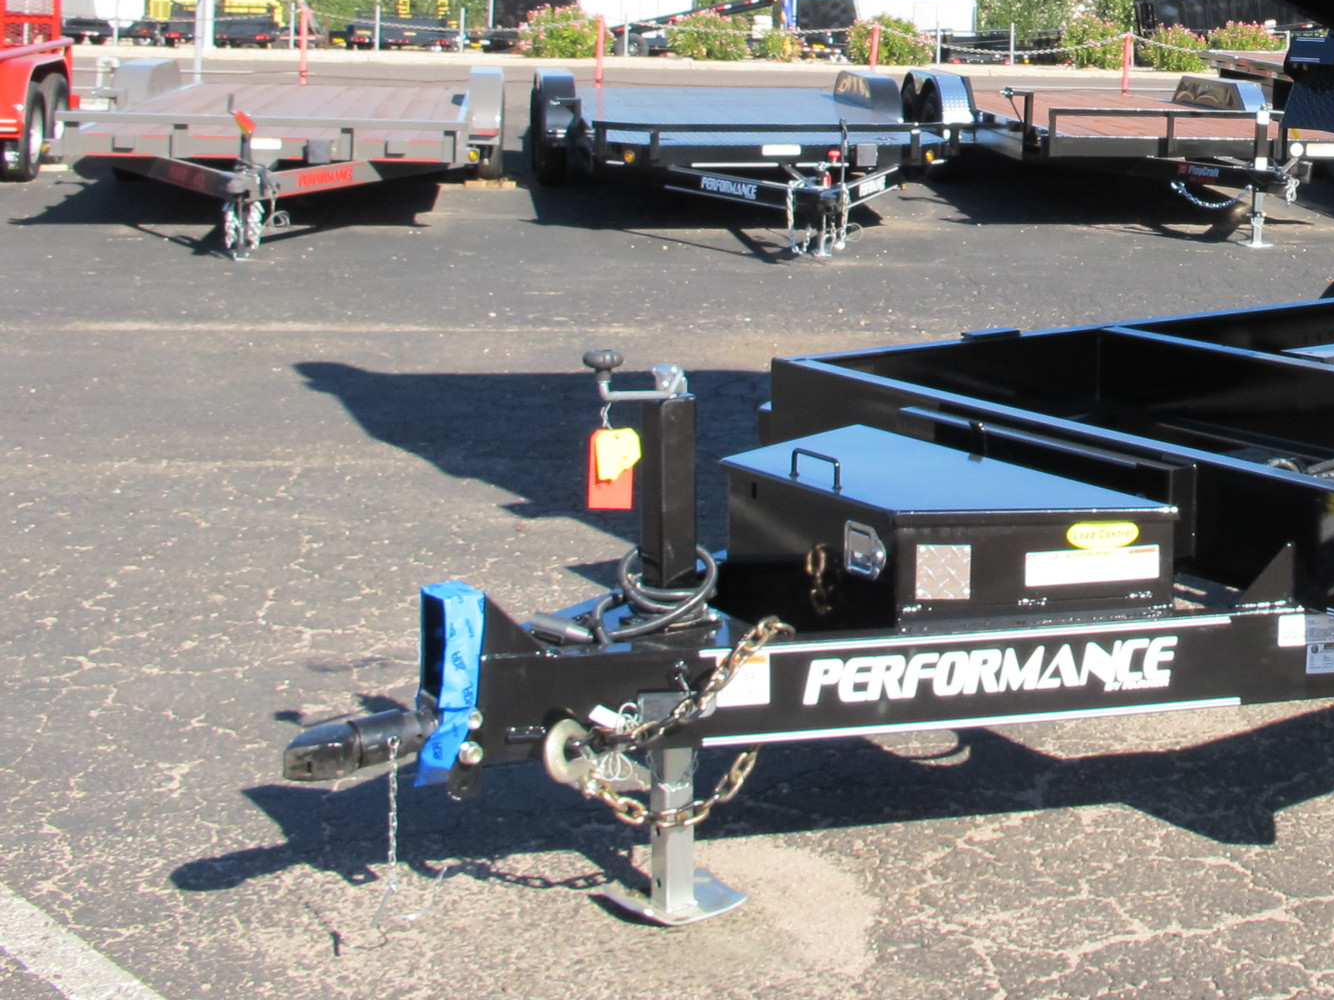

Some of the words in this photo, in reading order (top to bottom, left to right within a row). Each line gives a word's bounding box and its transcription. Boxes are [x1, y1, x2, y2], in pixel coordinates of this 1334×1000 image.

[701, 176, 757, 197] PERFORMANCE
[1073, 530, 1095, 540] Load
[1099, 528, 1135, 539] Control
[802, 635, 1179, 706] PERFORMANCE
